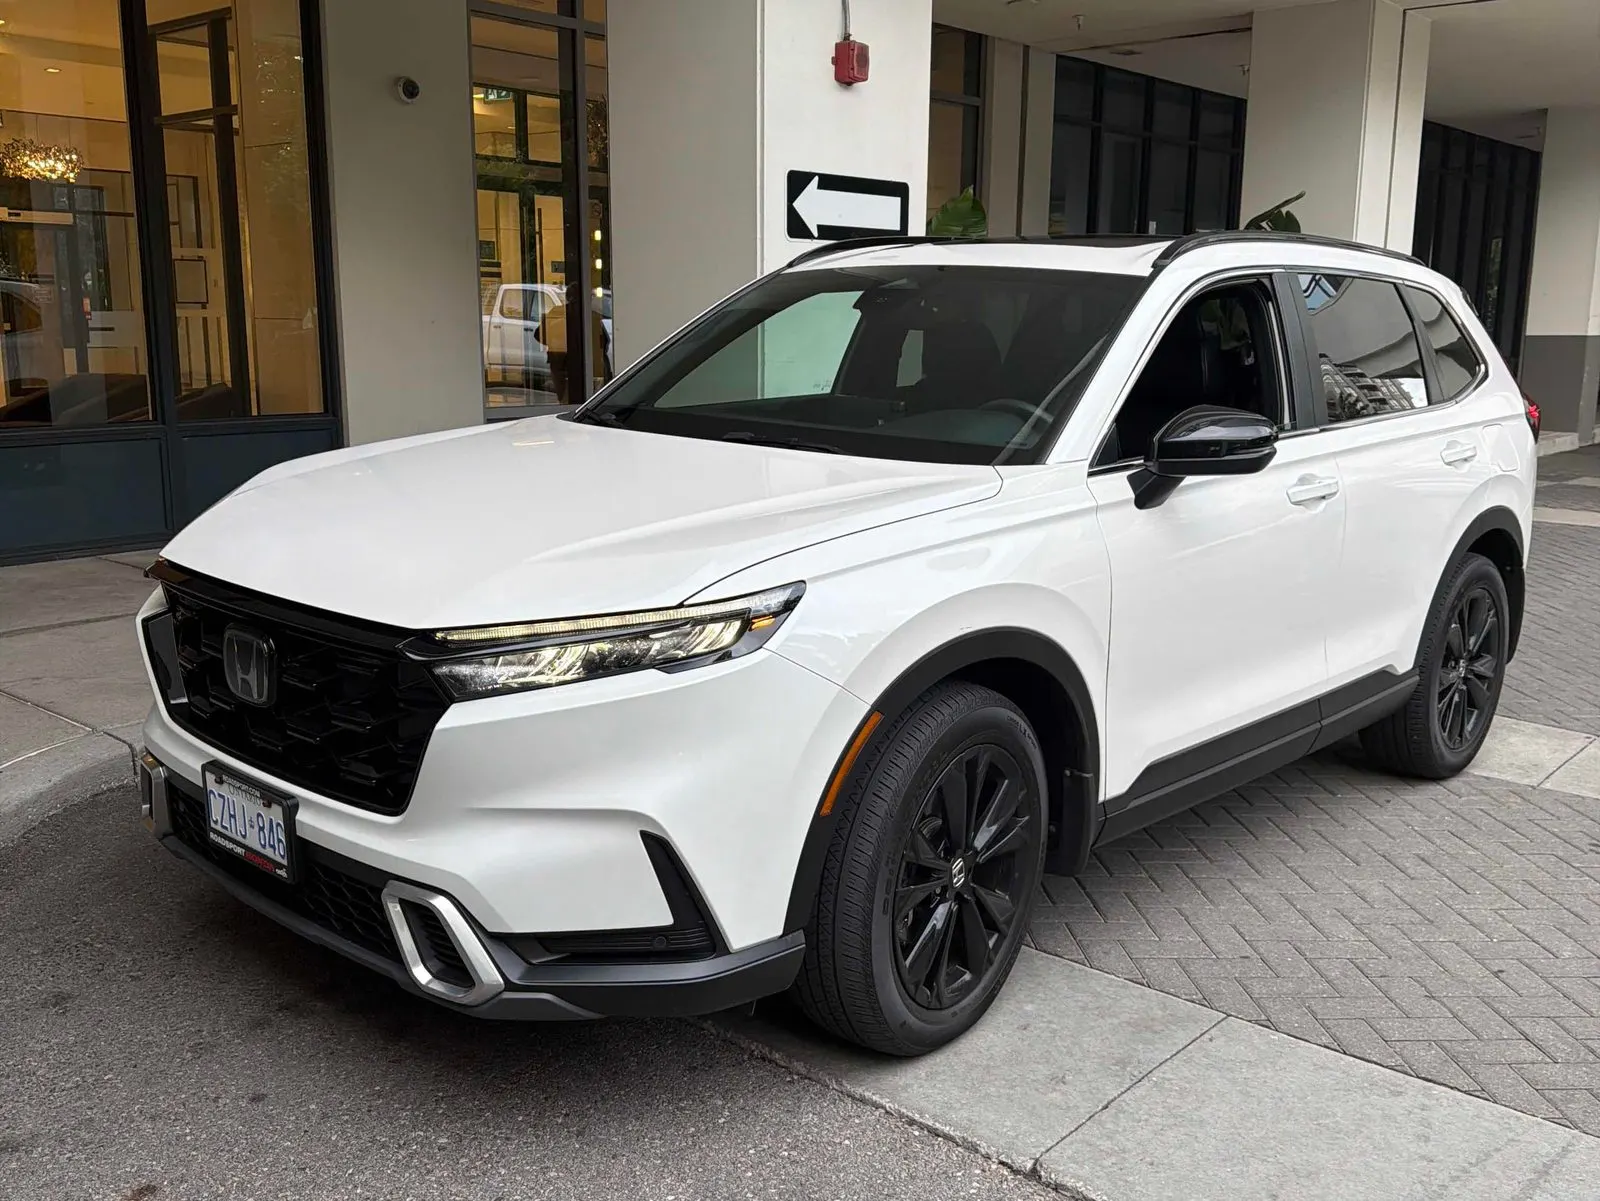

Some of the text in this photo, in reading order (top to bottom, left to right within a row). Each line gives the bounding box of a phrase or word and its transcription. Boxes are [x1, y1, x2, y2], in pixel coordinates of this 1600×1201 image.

[207, 788, 286, 860] CZHJ 846
[210, 831, 246, 857] ROADSPORT
